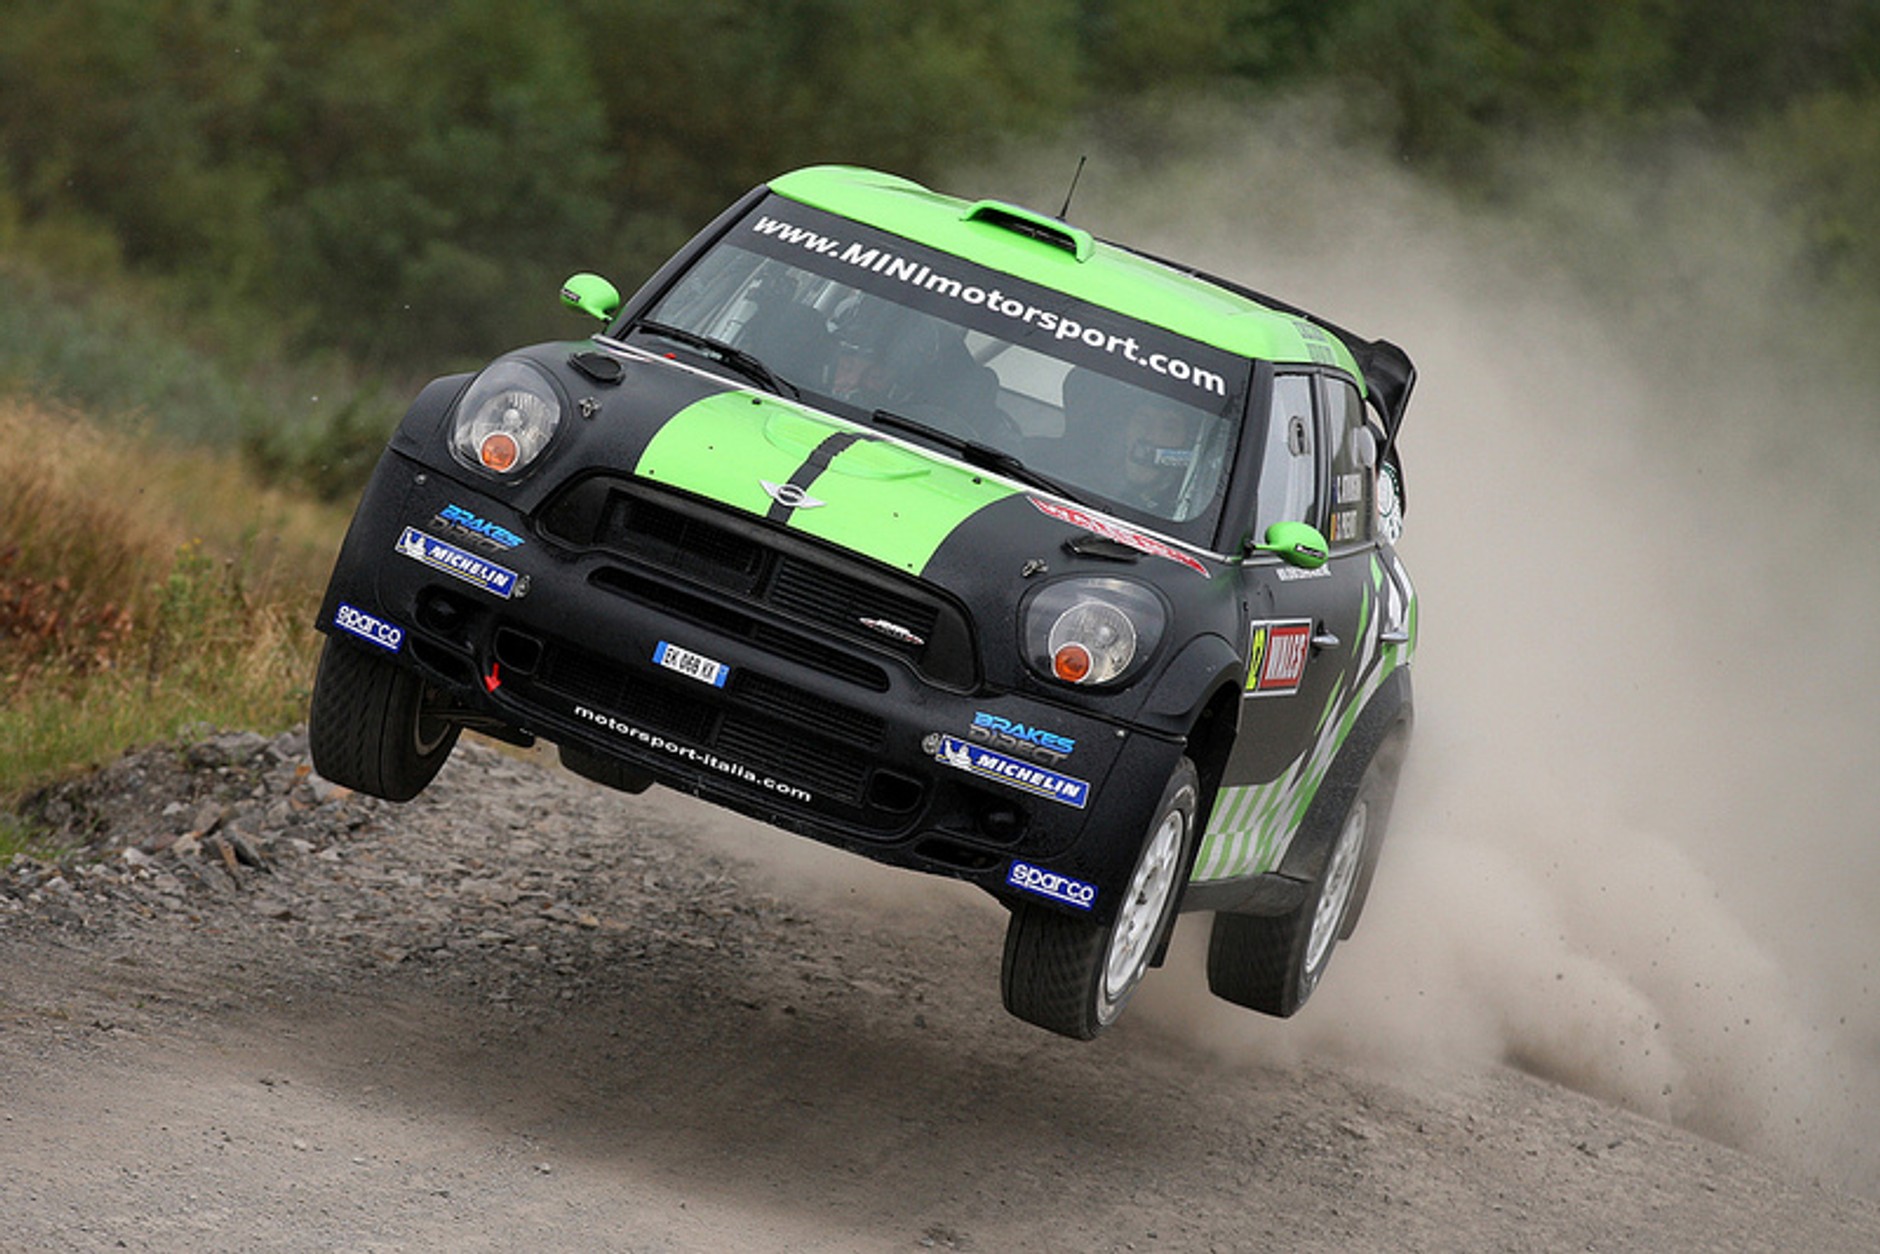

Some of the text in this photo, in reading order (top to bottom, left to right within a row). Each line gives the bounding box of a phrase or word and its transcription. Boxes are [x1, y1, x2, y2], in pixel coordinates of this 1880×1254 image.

[752, 215, 1226, 396] www.MINImotorsport.com
[439, 504, 525, 548] BRAKES
[429, 546, 509, 587] MICHELIN
[338, 605, 401, 644] sparco
[574, 704, 812, 802] motorsport-italia.com
[973, 711, 1076, 754] BRAKES
[977, 754, 1081, 798] MICHELIN
[1012, 863, 1094, 901] sparco
